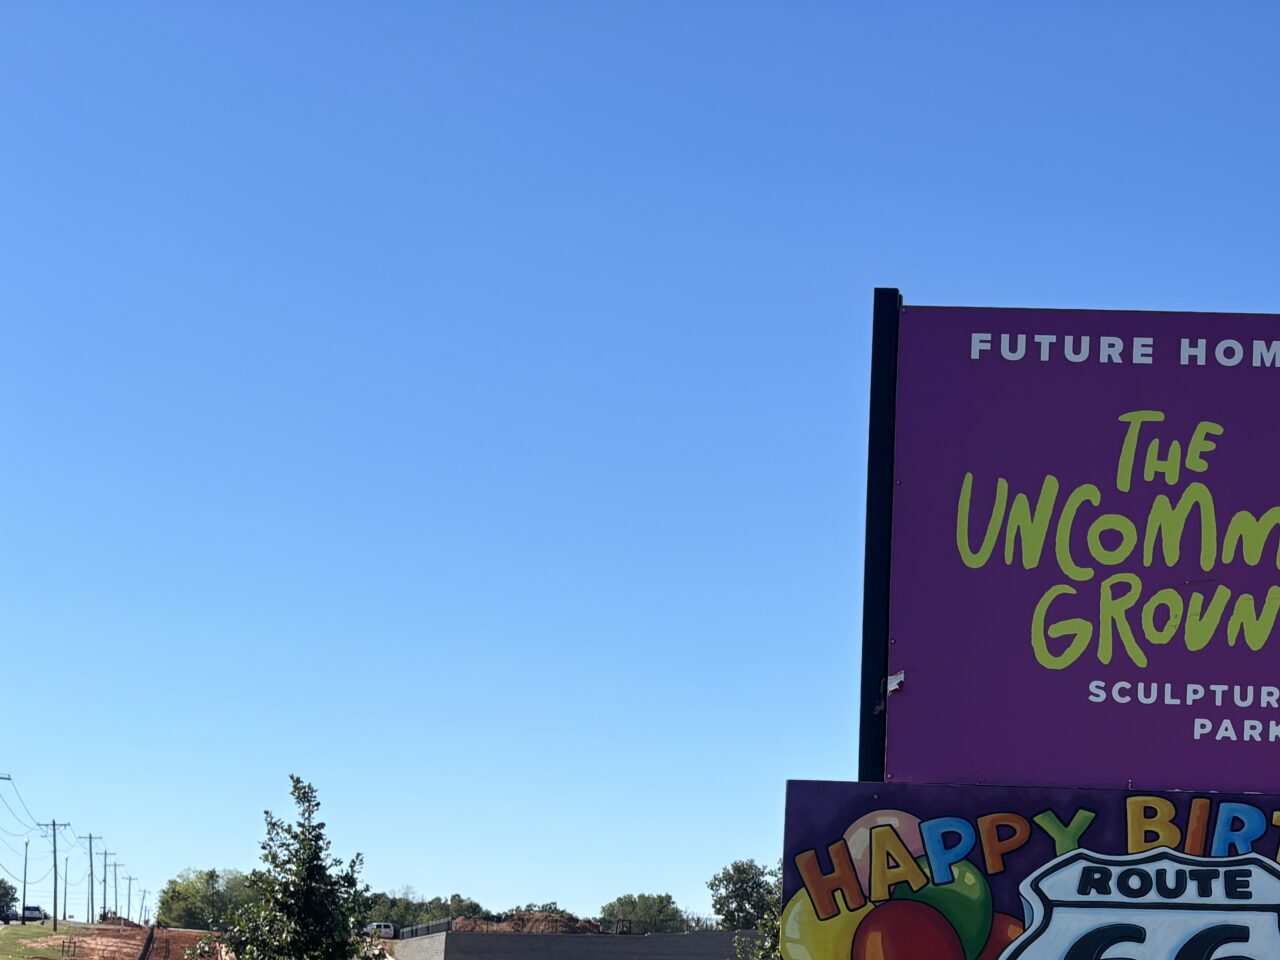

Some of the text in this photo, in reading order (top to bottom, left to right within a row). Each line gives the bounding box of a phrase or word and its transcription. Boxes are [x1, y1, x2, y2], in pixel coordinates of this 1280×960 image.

[970, 333, 1154, 364] FUTURE
[1117, 410, 1224, 492] THE
[794, 807, 1097, 920] HAPPY
[1077, 865, 1252, 900] ROUTE
